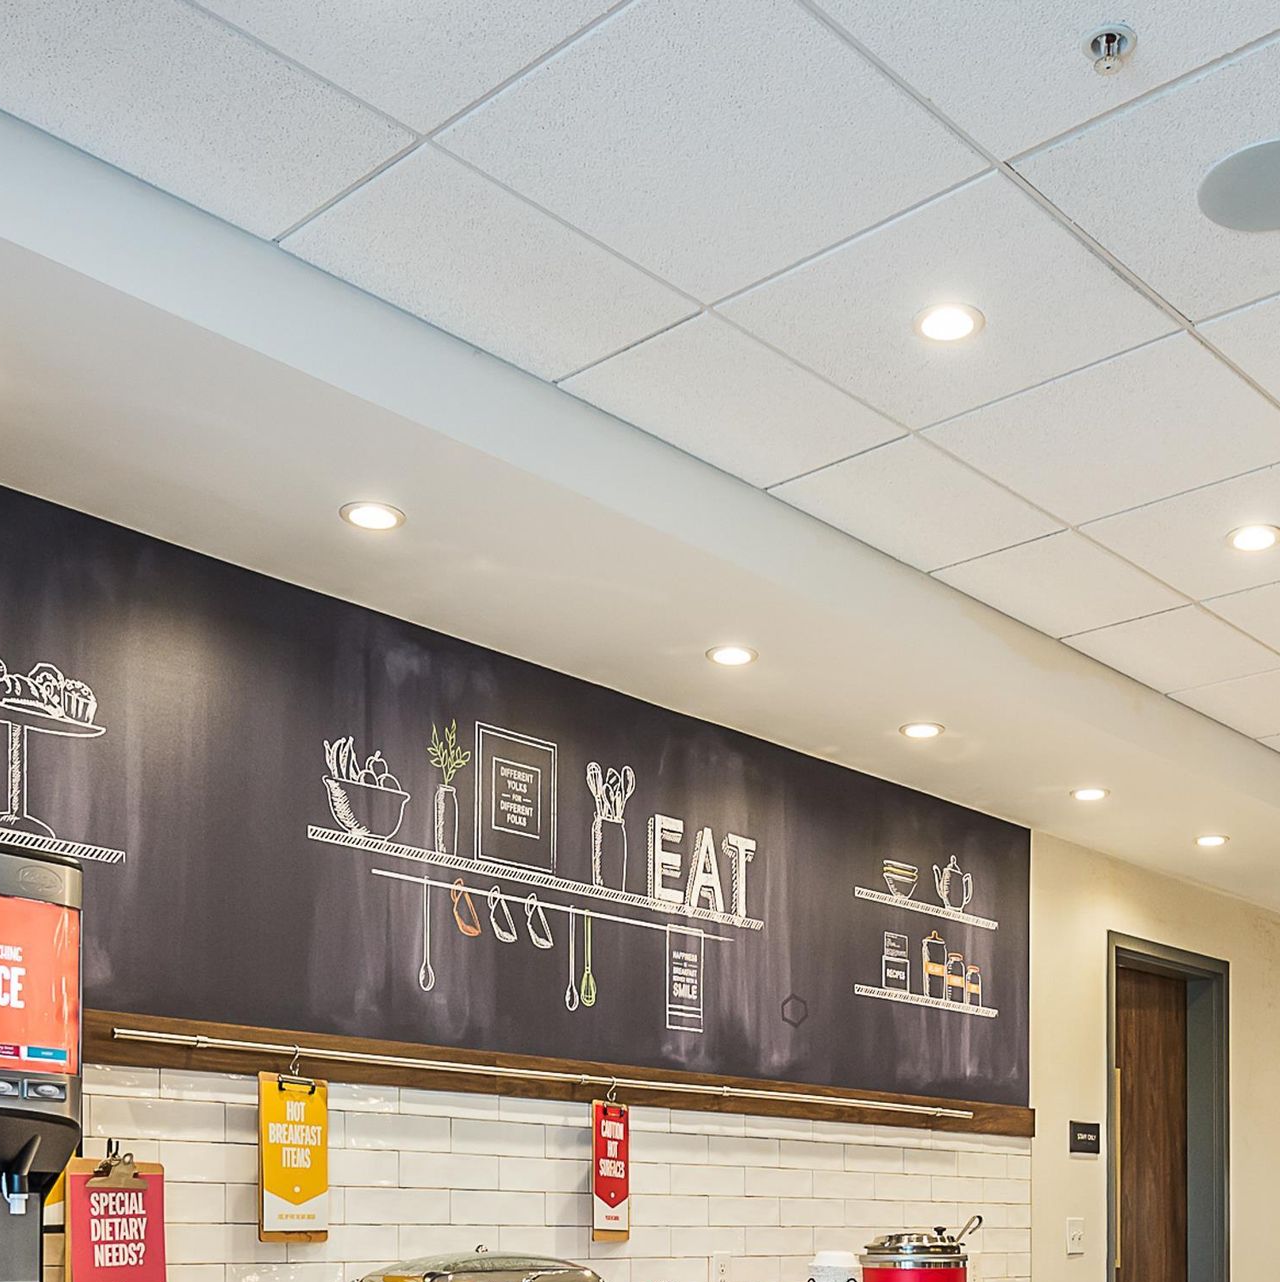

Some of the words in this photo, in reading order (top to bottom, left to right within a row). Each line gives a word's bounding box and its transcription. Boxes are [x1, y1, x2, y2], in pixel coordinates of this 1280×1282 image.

[500, 766, 534, 784] DIFFERENT
[507, 780, 528, 794] YOLKS
[512, 793, 522, 802] FOR
[500, 800, 533, 817] DIFFERENT
[506, 813, 527, 827] FOLKS
[647, 813, 757, 918] EAT
[672, 983, 698, 1001] SMILE
[286, 1100, 306, 1122] HOT
[268, 1122, 322, 1146] BREAKFAST
[601, 1119, 624, 1141] CAUTION
[282, 1147, 311, 1169] ITEMS
[607, 1141, 618, 1159] HOT
[599, 1158, 625, 1179] SURFACES
[90, 1192, 146, 1216] SPECIAL
[90, 1217, 147, 1242] DIETARY
[94, 1242, 146, 1267] NEEDS?
